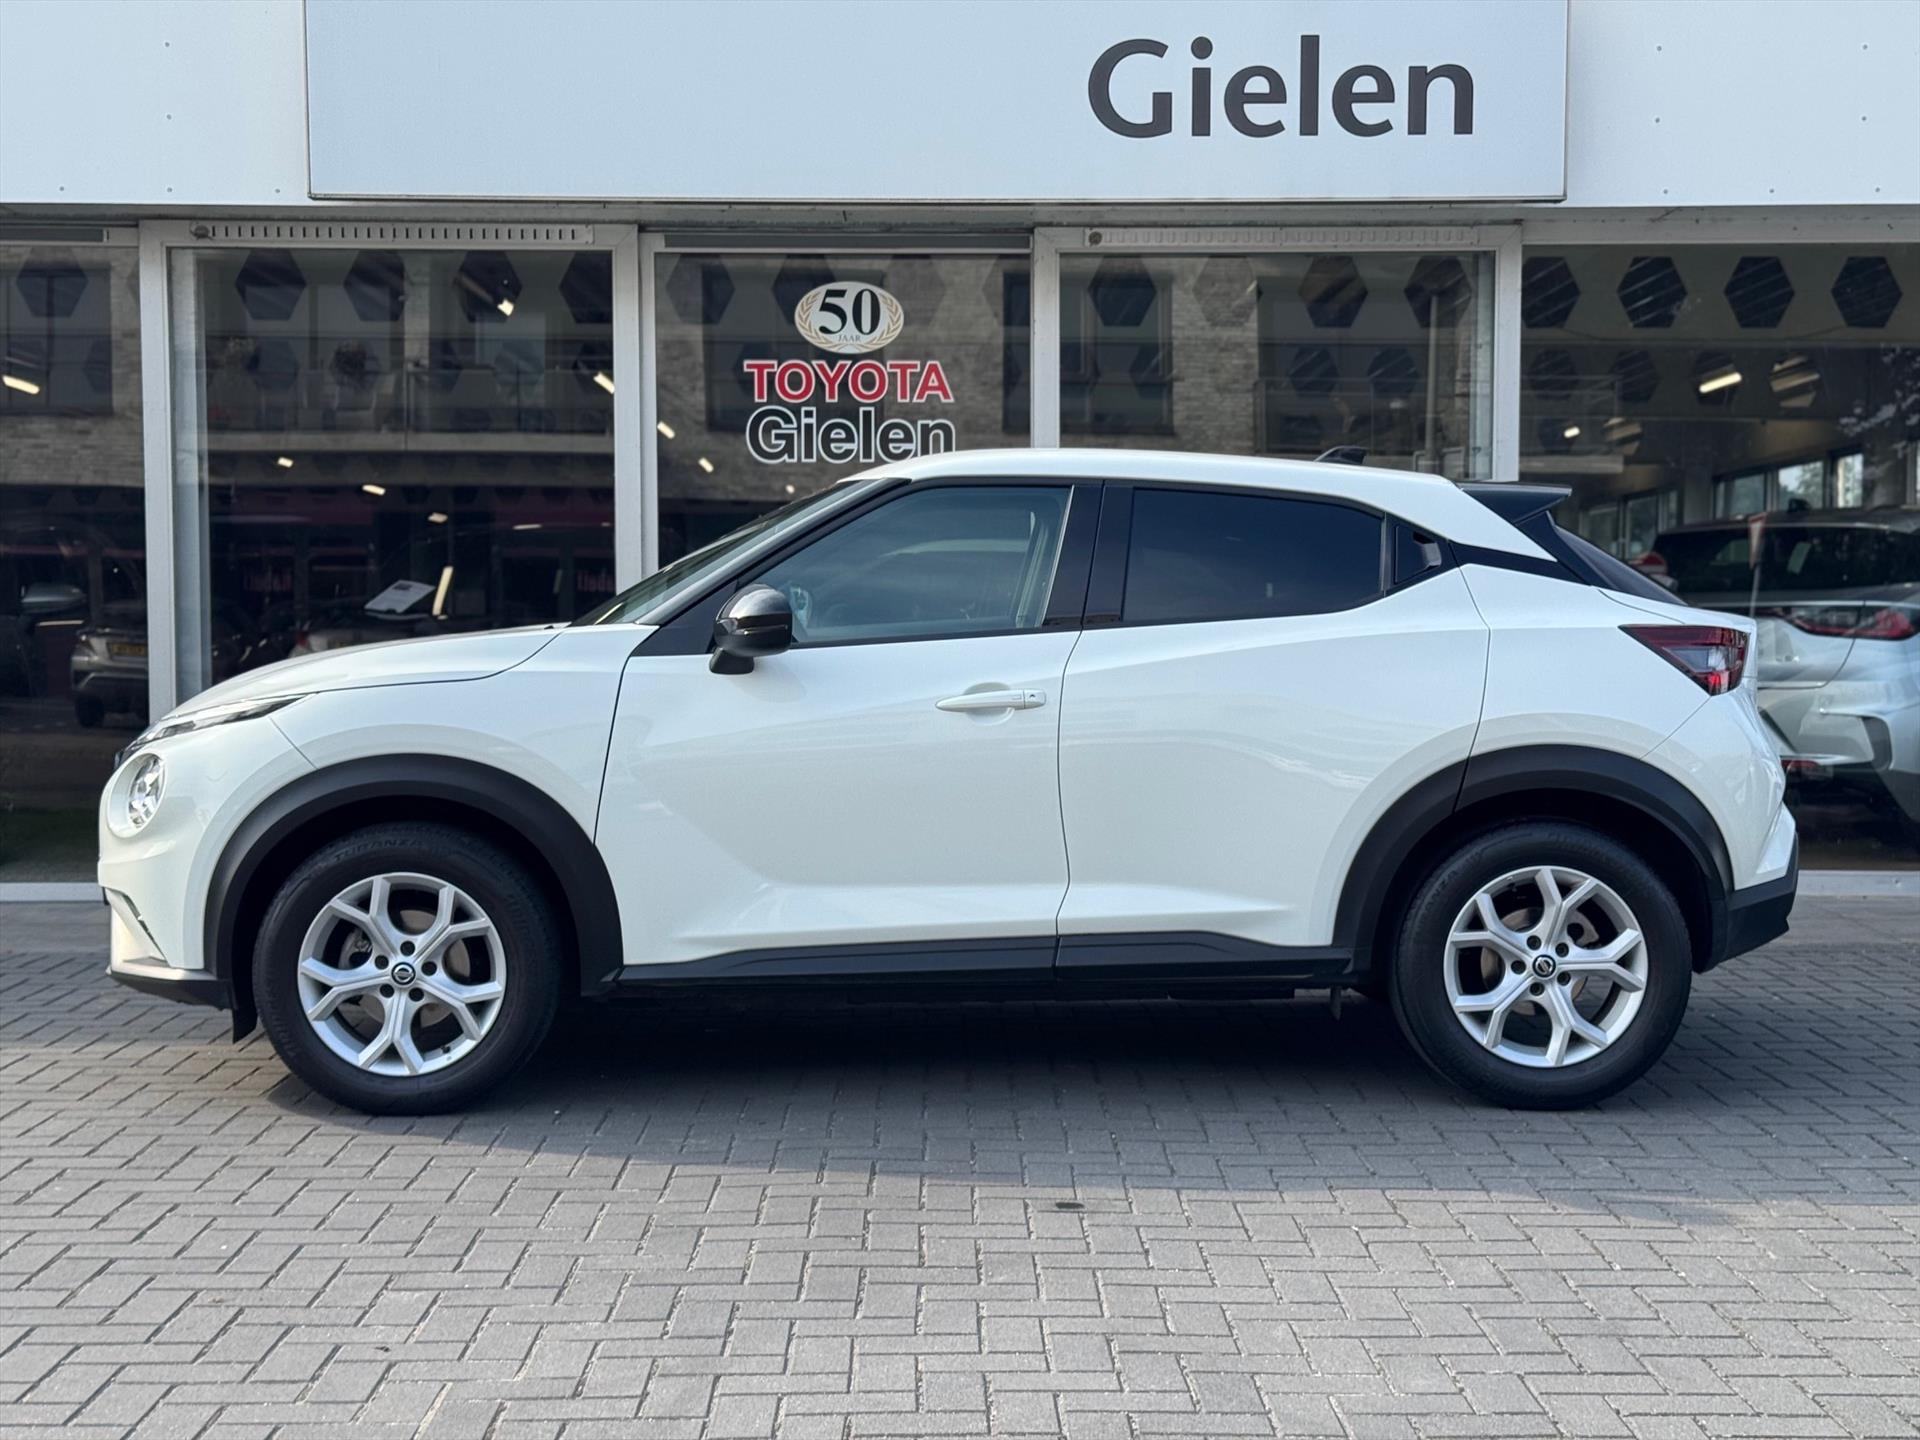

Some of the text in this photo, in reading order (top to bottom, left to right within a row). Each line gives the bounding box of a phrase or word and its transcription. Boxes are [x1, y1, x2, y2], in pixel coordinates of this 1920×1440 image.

[1088, 34, 1474, 139] Gielen
[818, 288, 881, 336] 50
[838, 334, 862, 343] JAAR
[743, 359, 955, 403] TOYOTA
[745, 404, 956, 464] Gielen
